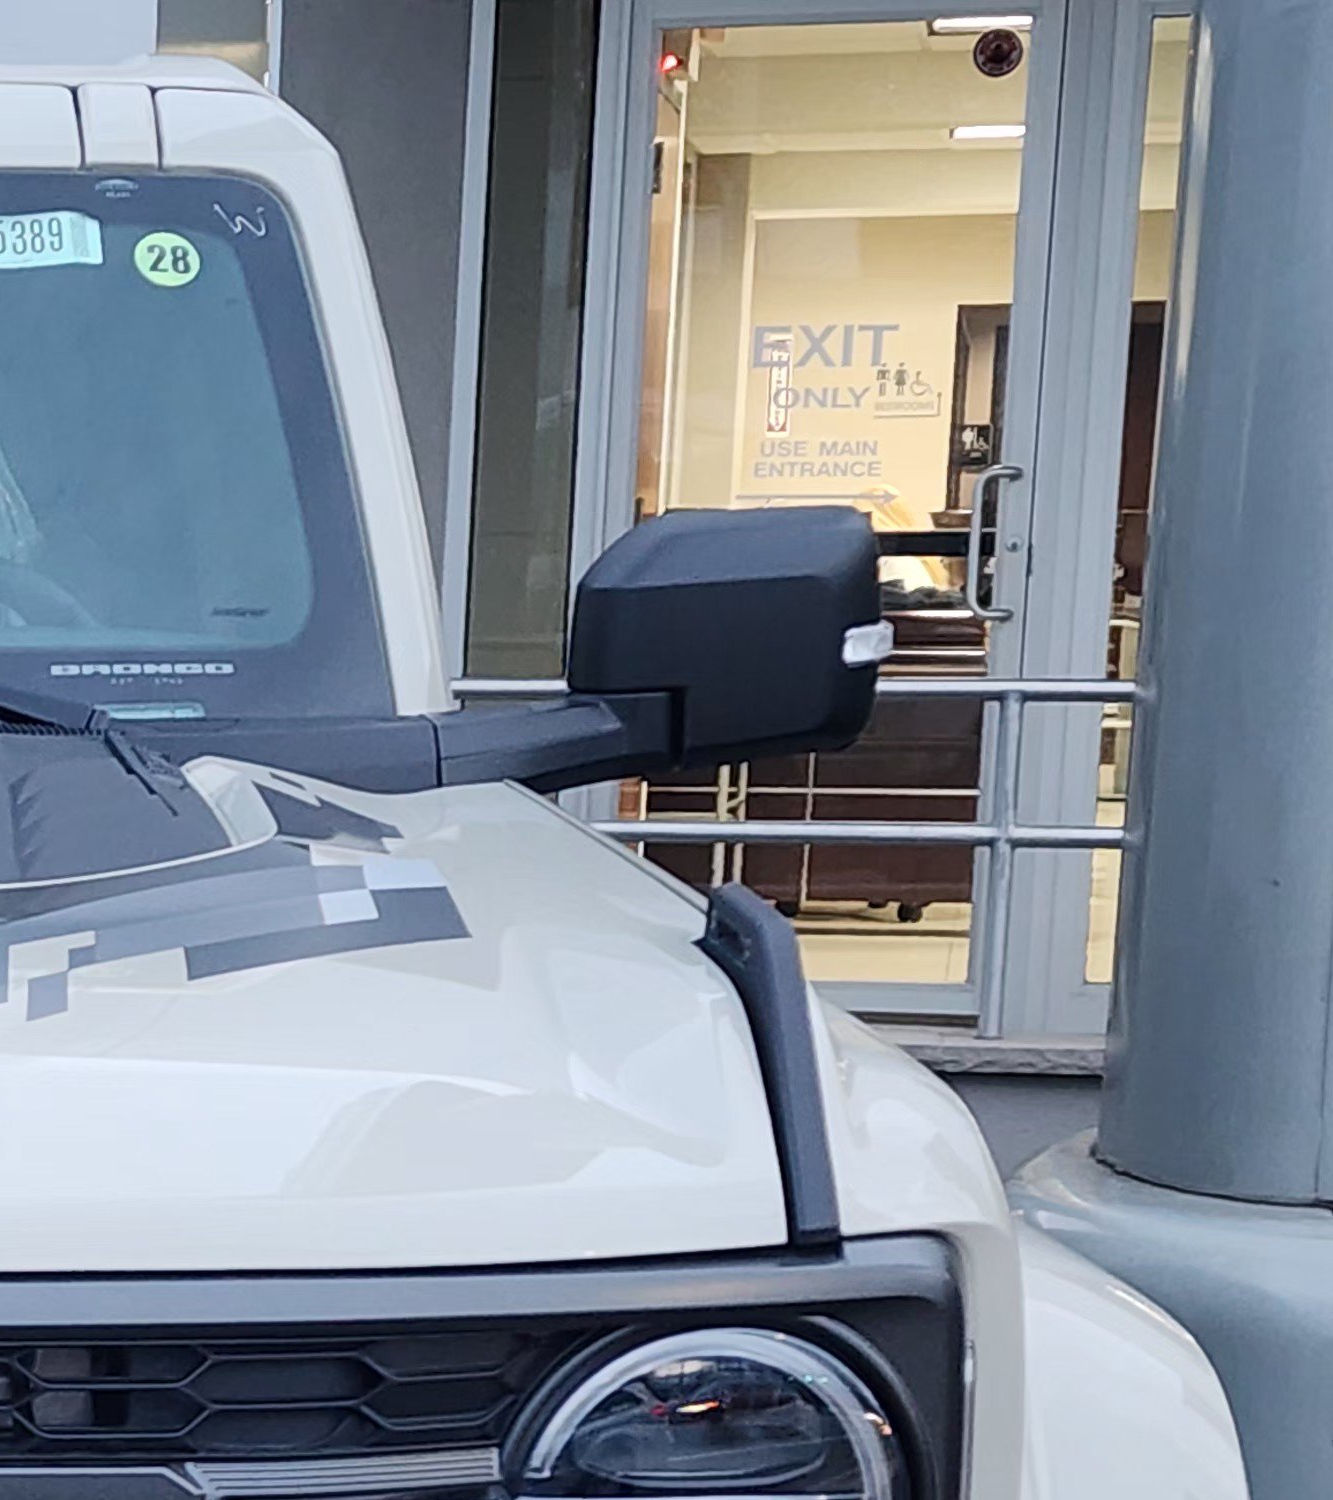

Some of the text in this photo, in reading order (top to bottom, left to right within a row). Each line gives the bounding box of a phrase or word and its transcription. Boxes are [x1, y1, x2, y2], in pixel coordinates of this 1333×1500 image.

[146, 244, 192, 275] 28
[751, 323, 900, 369] EXIT
[773, 386, 871, 409] ONLY
[760, 440, 878, 458] USE MAIN
[753, 460, 882, 479] ENTRANCE
